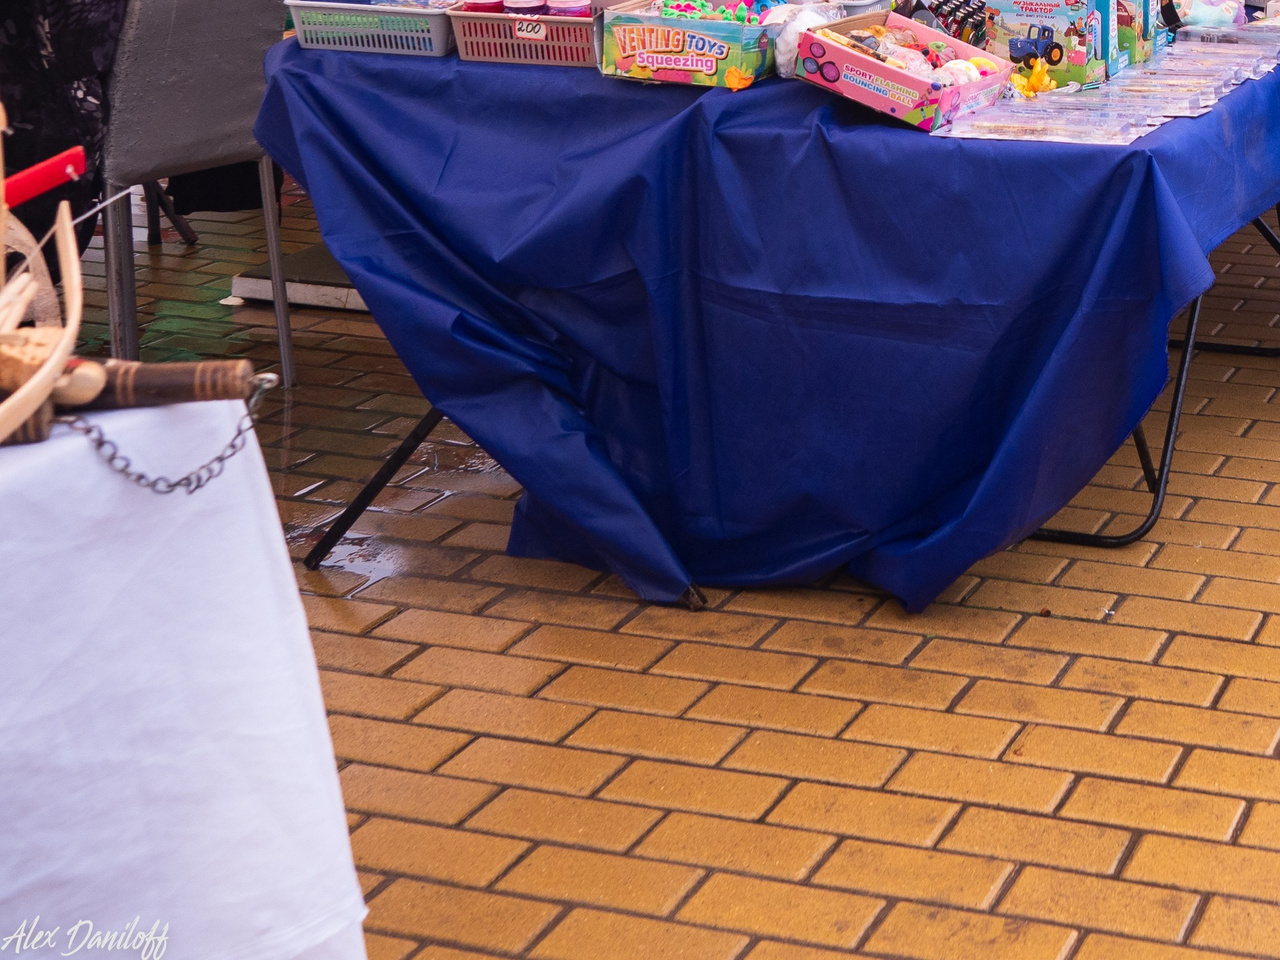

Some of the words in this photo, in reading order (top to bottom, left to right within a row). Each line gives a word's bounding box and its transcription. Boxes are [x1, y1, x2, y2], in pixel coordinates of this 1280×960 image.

[1012, 0, 1061, 9] МУЗЫКАЛЬНЫЙ
[1020, 6, 1054, 14] ТРАКТОР
[517, 20, 542, 35] 200
[615, 25, 683, 55] VENTING
[687, 32, 727, 56] TOYS
[637, 52, 715, 72] Squeezing
[842, 73, 889, 97] BOUNCING
[890, 93, 914, 107] BALL
[844, 64, 873, 81] SPORT
[873, 76, 918, 100] FLASHING
